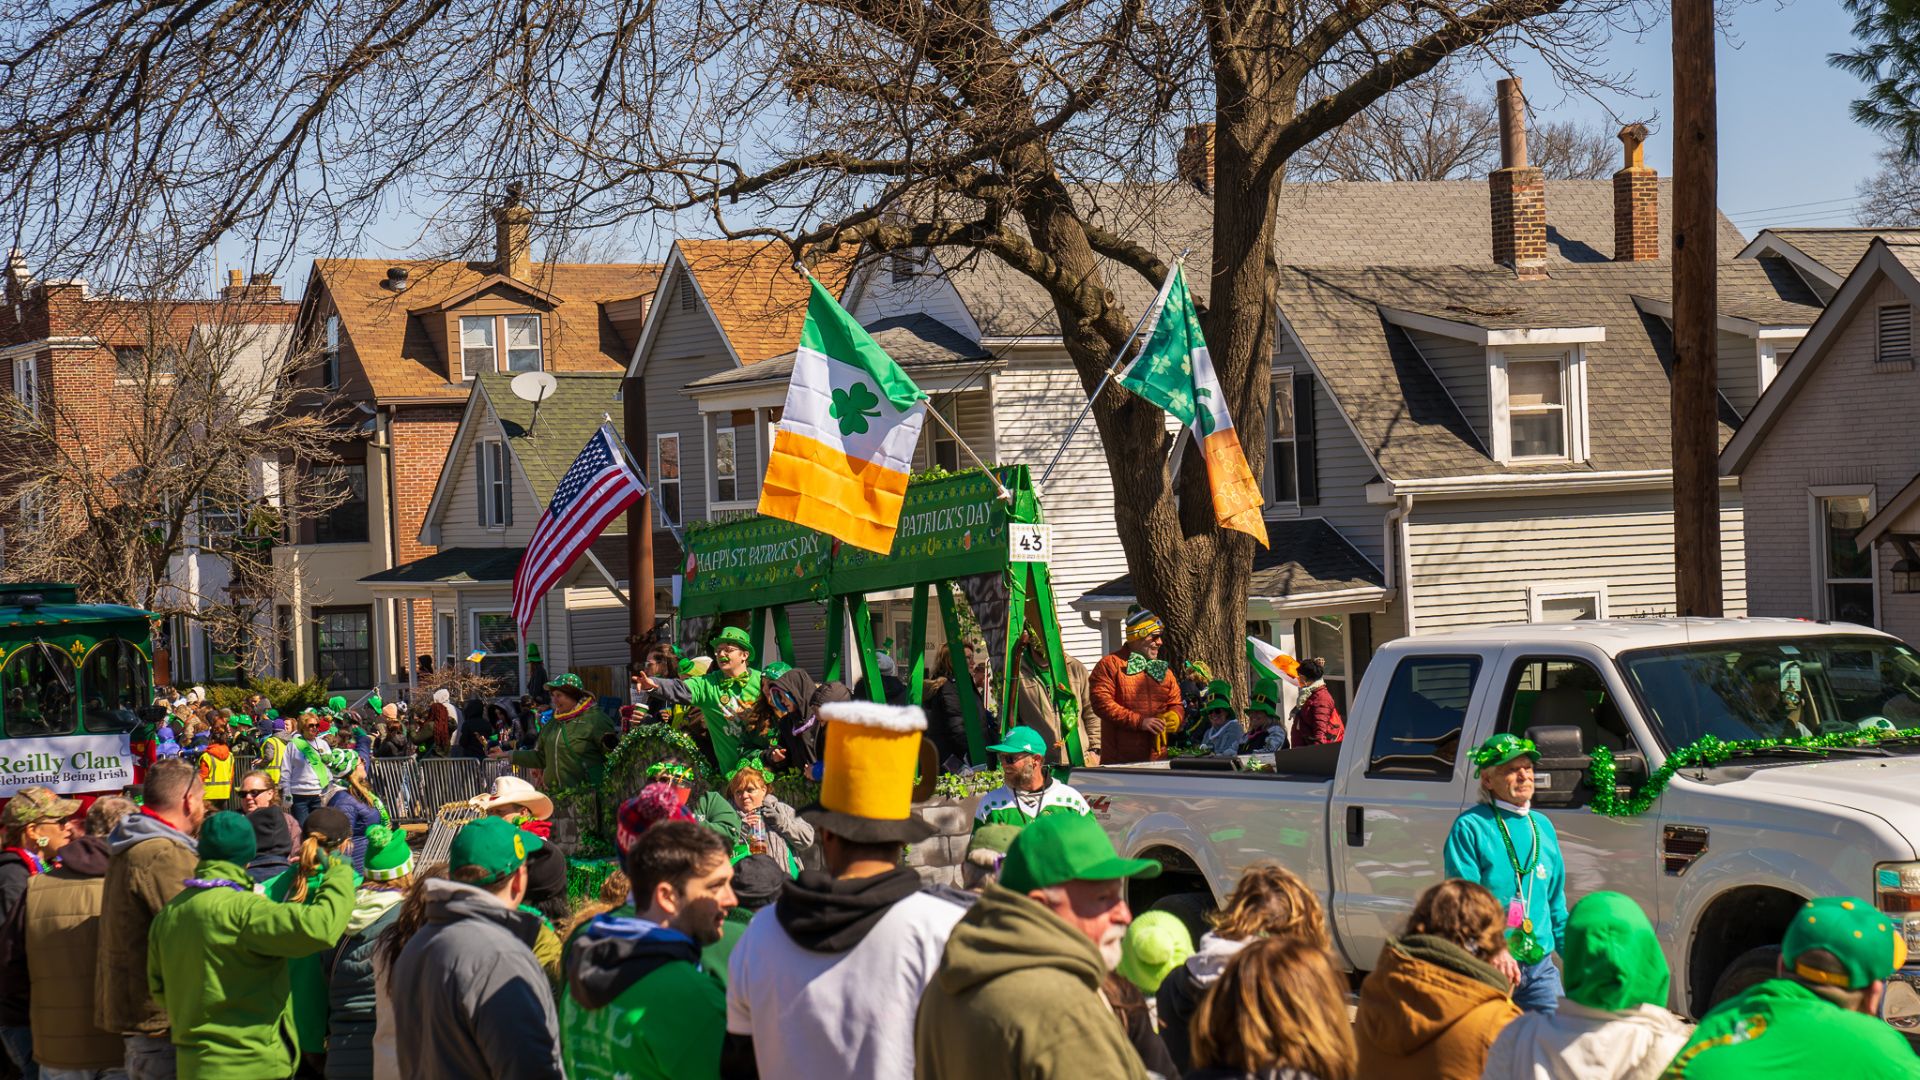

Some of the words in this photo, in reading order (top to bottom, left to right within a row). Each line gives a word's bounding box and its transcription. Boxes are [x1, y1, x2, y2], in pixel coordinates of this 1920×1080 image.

[902, 506, 964, 538] PATRICK'S
[966, 500, 994, 527] DAY
[730, 546, 747, 568] ST.
[748, 538, 799, 566] PATRICK'S
[799, 533, 820, 556] DAY
[1020, 534, 1042, 551] 43
[0, 753, 66, 775] Reilly
[71, 751, 122, 770] Clan
[0, 772, 60, 785] lebrating
[63, 771, 96, 783] Being
[99, 769, 128, 780] Irish
